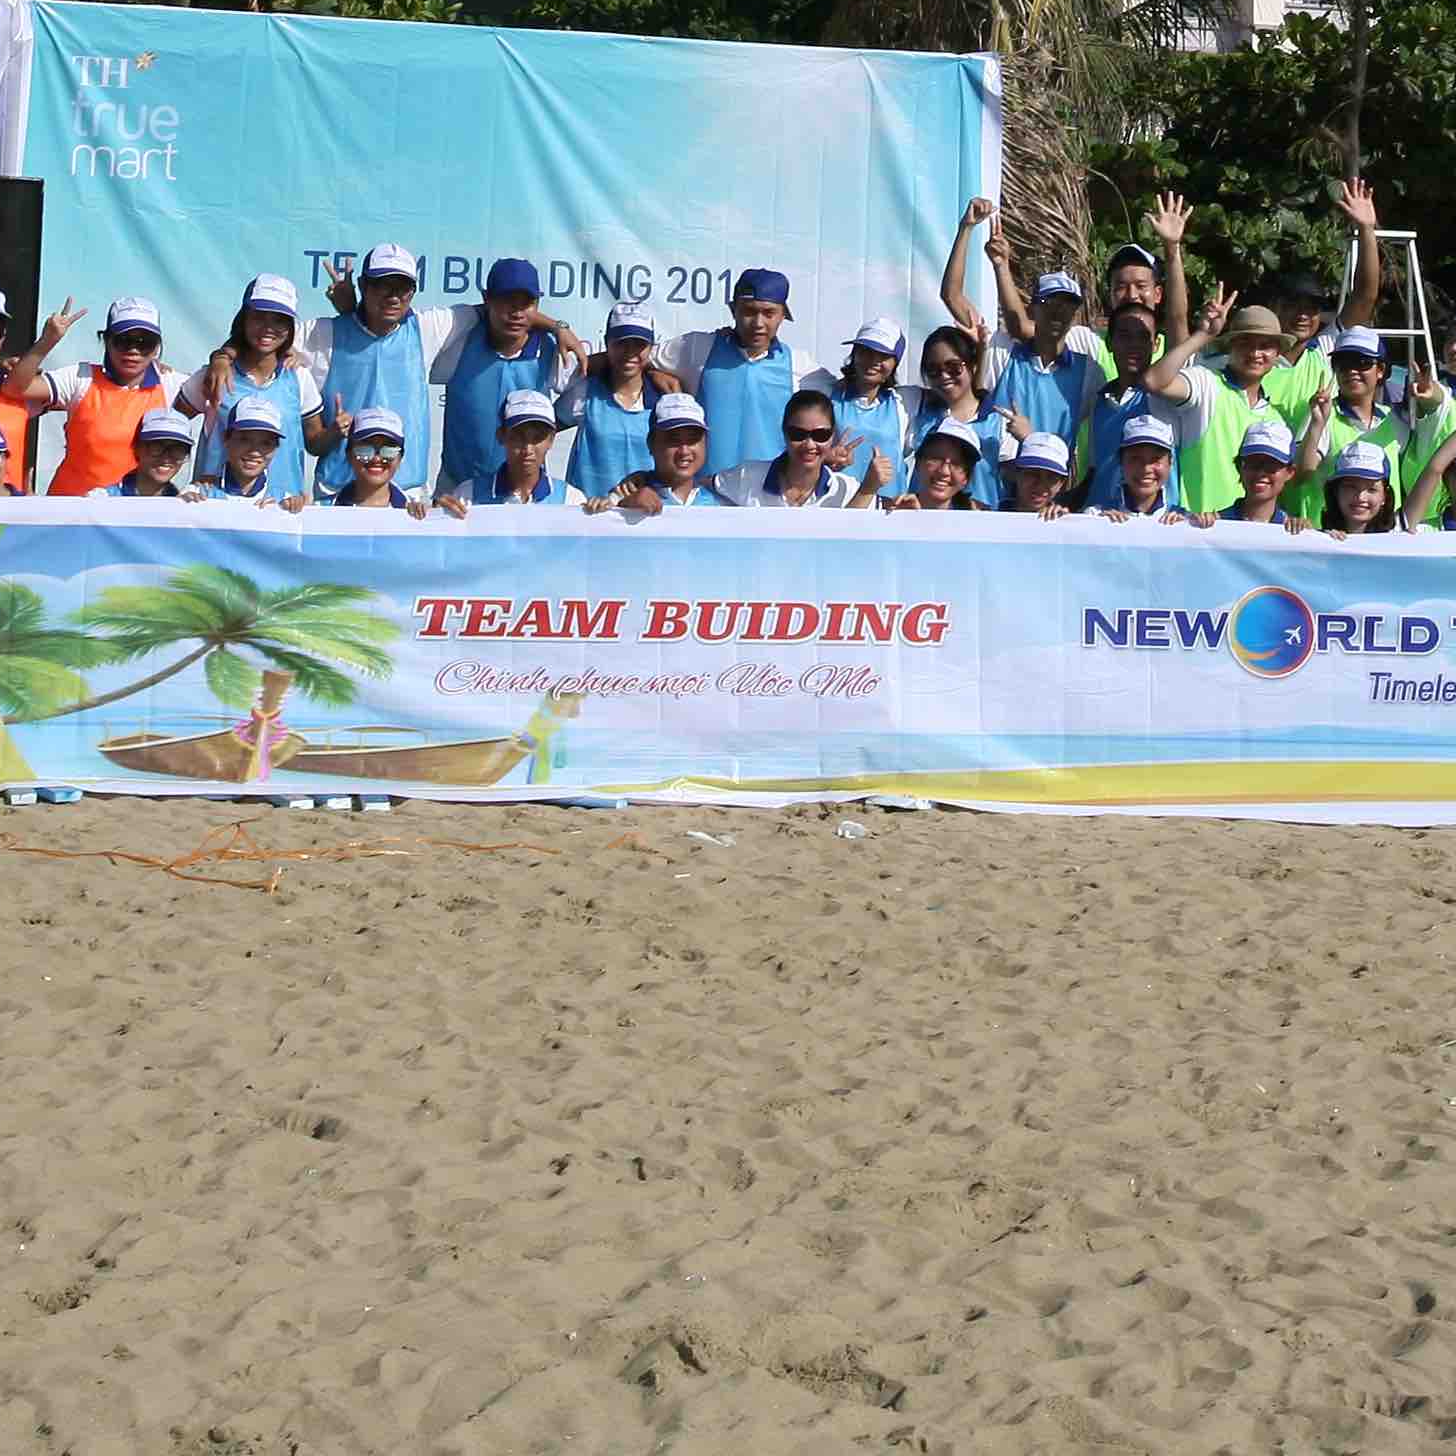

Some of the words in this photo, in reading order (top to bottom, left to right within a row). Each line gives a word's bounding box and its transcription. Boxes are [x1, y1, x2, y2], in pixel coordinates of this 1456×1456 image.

[72, 55, 129, 89] TH
[72, 91, 179, 143] true
[71, 143, 178, 181] mart
[304, 250, 426, 293] TE
[442, 256, 653, 303] BUDING
[665, 266, 736, 306] 201
[415, 599, 625, 639] TEAM
[645, 601, 949, 644] BUIDING
